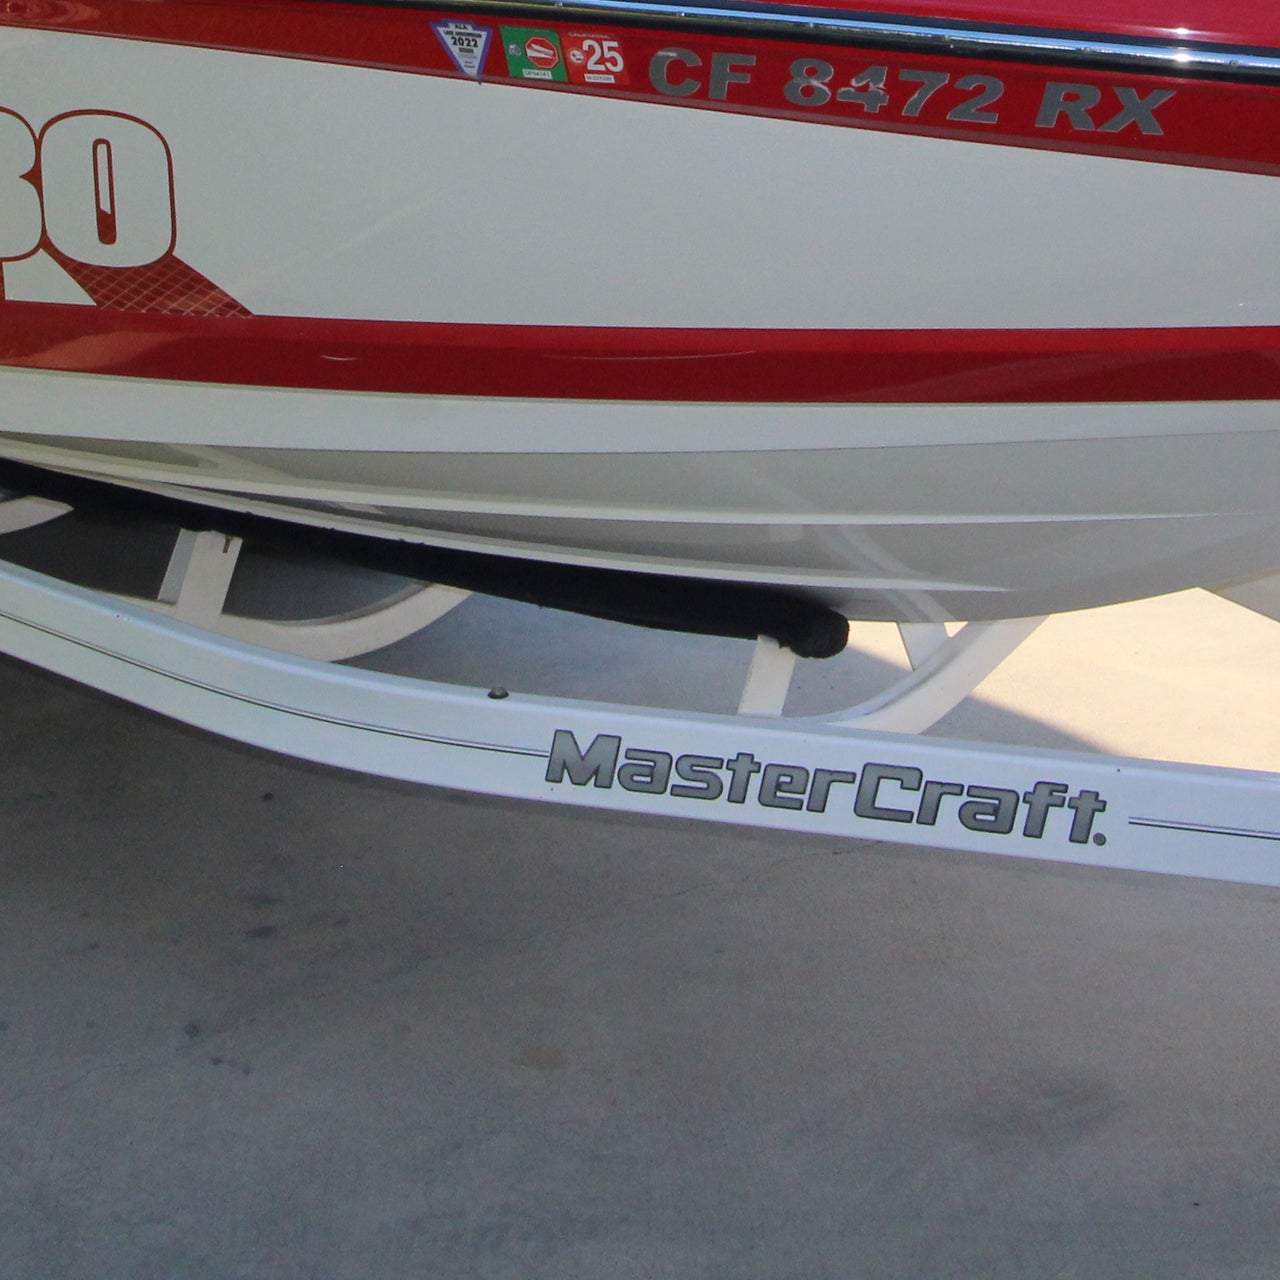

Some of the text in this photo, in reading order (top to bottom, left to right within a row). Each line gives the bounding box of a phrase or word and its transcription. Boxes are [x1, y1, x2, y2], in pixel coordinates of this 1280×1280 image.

[451, 36, 479, 48] 2022
[582, 39, 625, 73] 25
[649, 47, 1176, 136] CF 8472 RX
[545, 729, 1108, 846] MasterCraft
